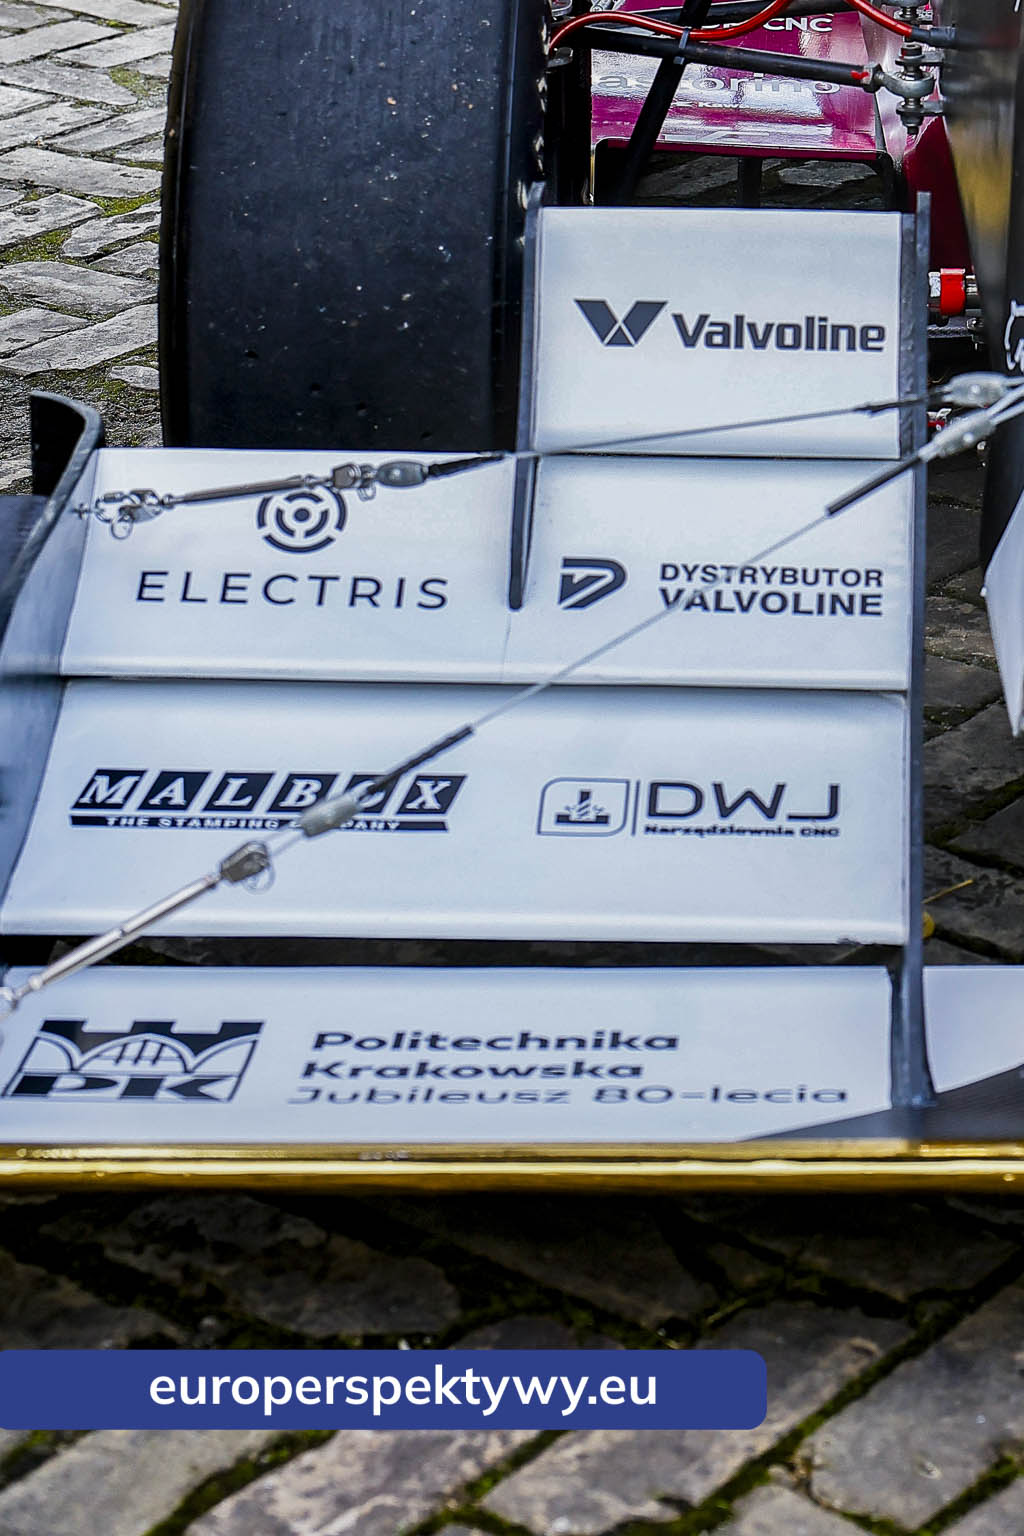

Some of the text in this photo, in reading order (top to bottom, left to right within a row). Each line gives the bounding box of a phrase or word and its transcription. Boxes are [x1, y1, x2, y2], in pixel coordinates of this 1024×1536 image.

[671, 312, 887, 353] Valvoline
[659, 563, 885, 589] DYSTRYBUTOR
[136, 570, 450, 610] ELECTRIS
[659, 587, 885, 617] VALVOLINE
[78, 774, 453, 811] MALBOX
[647, 781, 841, 823] DWJ
[799, 827, 842, 838] CNC
[312, 1030, 680, 1052] Politechnika
[301, 1060, 644, 1080] Krakowska
[10, 1074, 240, 1100] PK
[288, 1084, 850, 1105] Jubileusz 80-lecia
